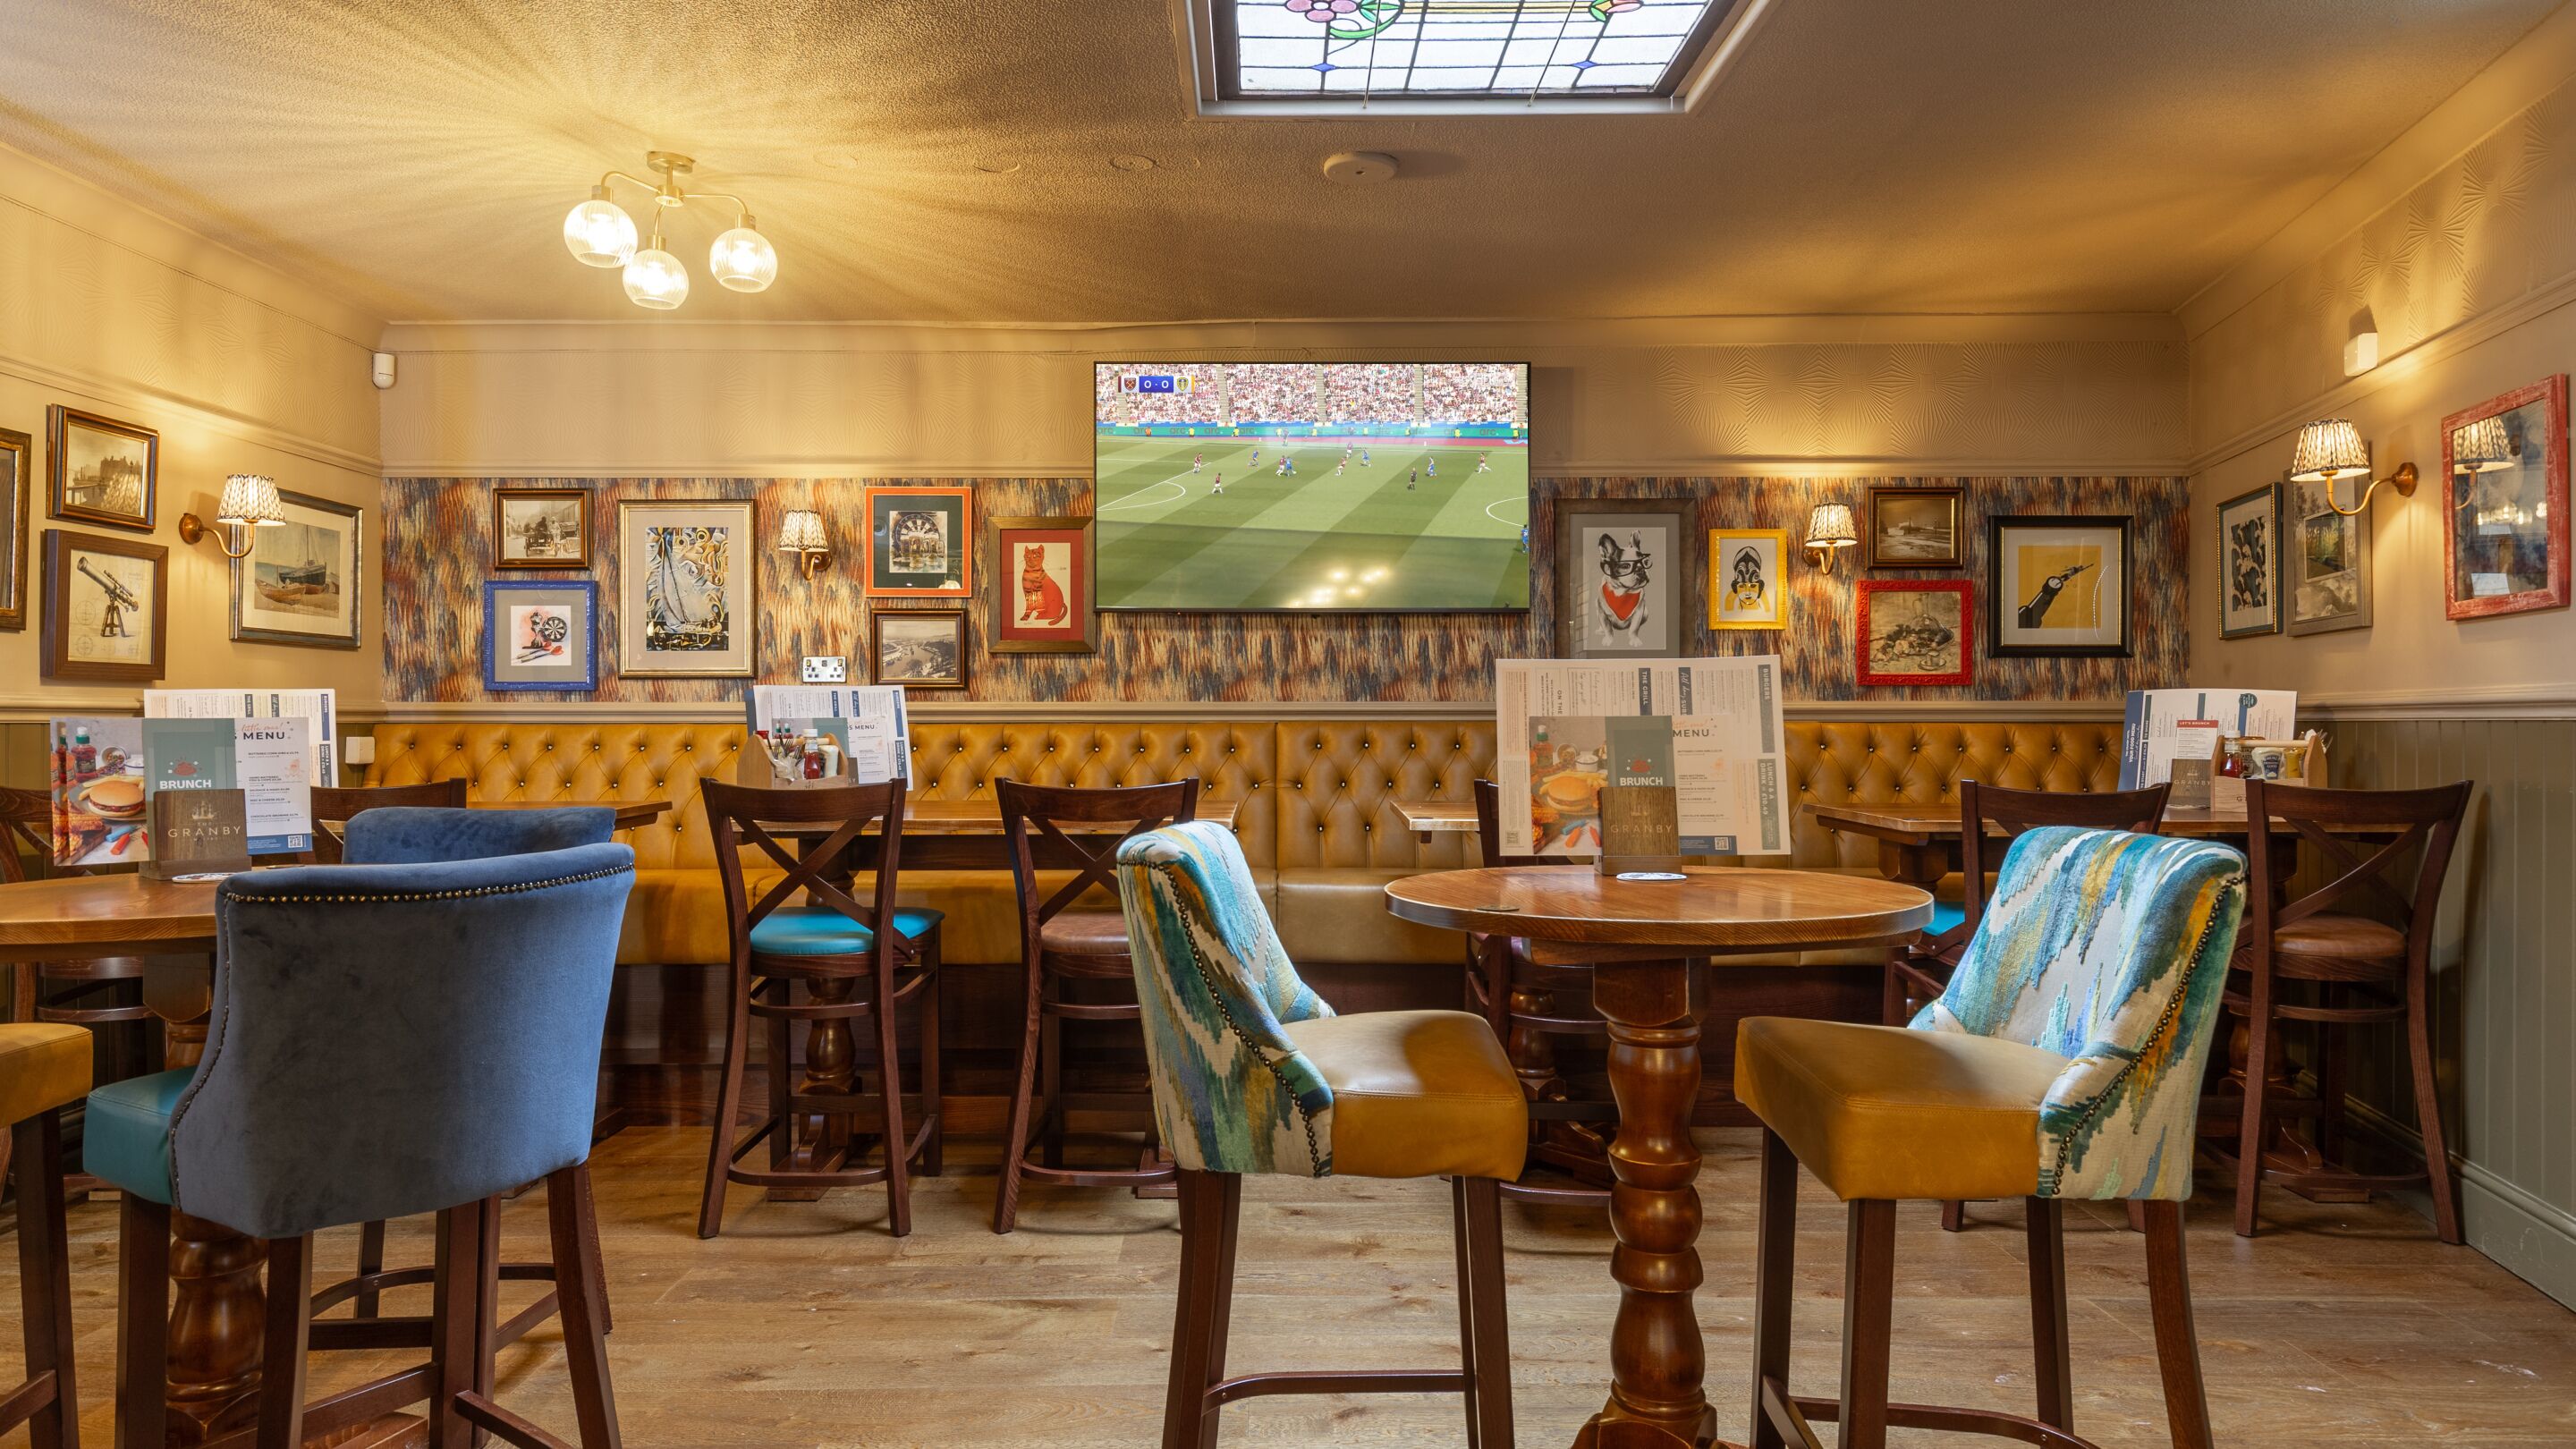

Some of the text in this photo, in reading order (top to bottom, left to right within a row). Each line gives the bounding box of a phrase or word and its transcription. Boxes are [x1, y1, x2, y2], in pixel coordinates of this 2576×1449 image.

[1144, 380, 1169, 389] 0 0
[1762, 668, 1770, 700] BURGERS
[243, 732, 284, 740] MENU
[1673, 729, 1709, 737] MENU
[159, 779, 212, 789] BRUNCH
[1620, 777, 1663, 786] BRUNCH
[168, 826, 241, 837] GRANBY
[1610, 825, 1672, 834] GRANBY
